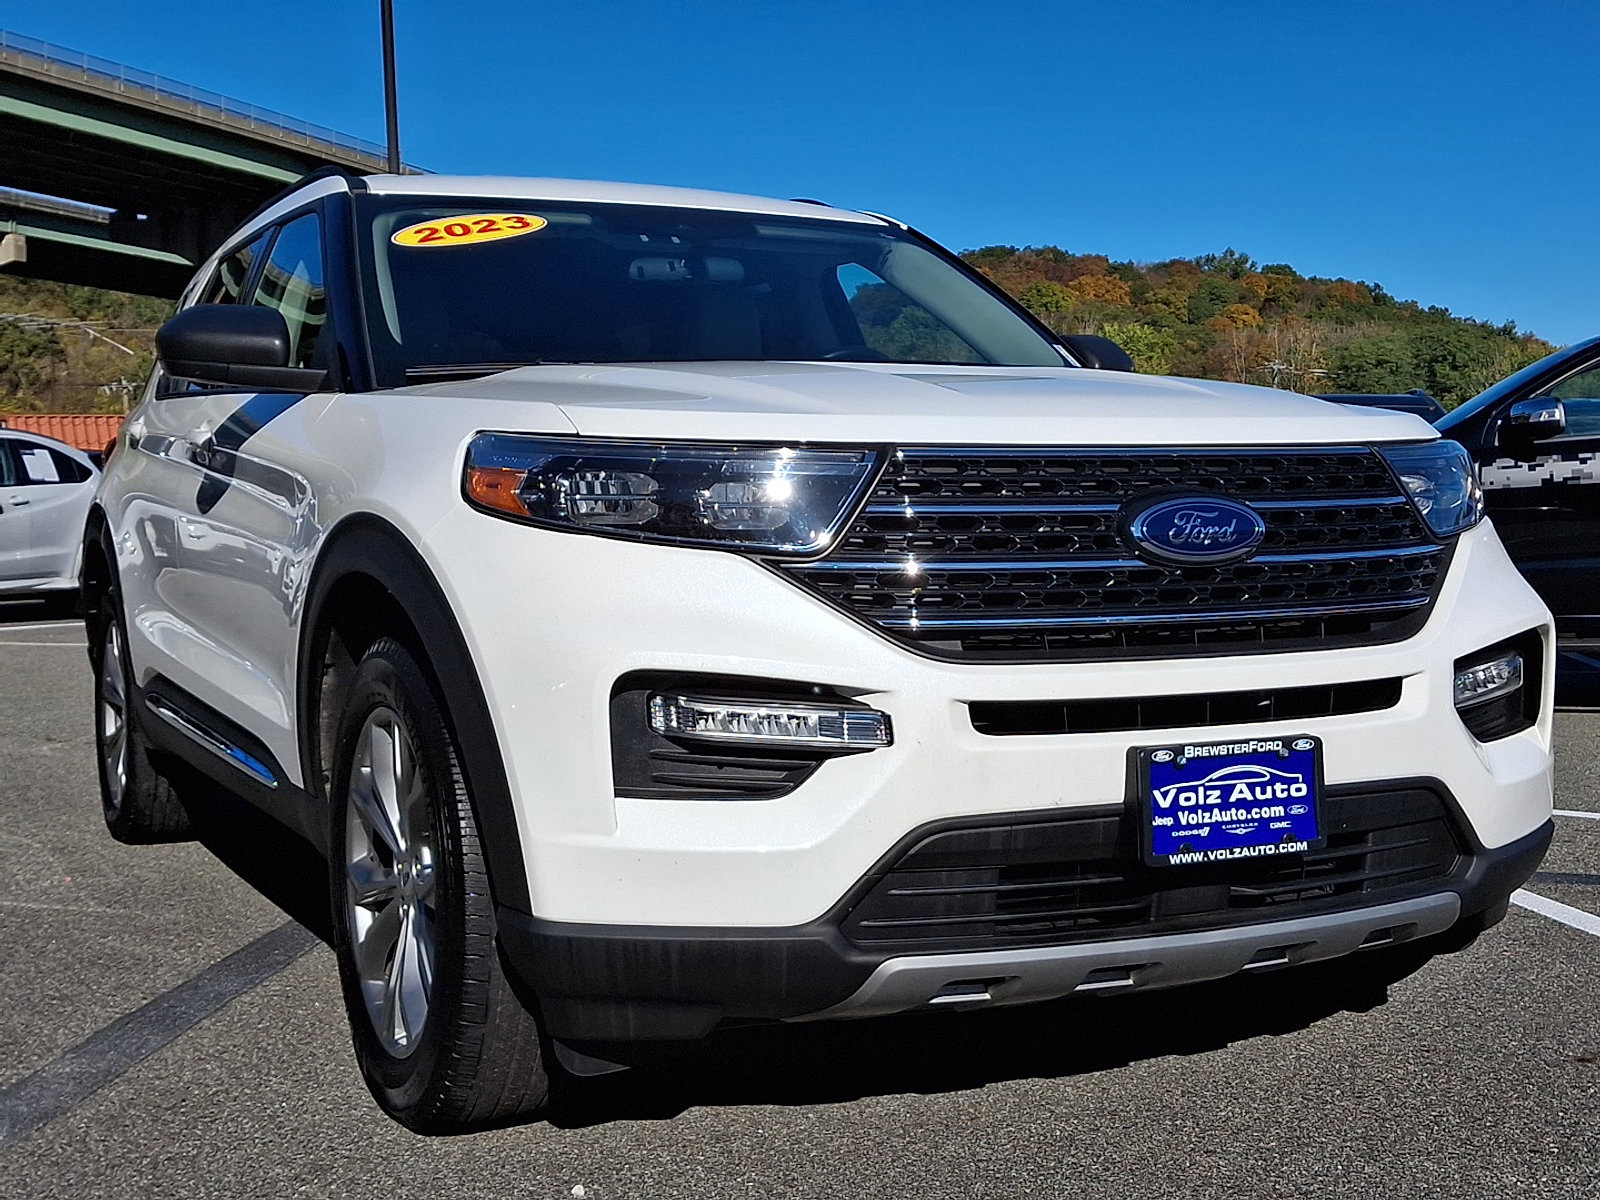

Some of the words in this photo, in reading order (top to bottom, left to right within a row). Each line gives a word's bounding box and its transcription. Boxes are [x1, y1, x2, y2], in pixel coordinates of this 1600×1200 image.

[414, 216, 531, 243] 2023
[1169, 510, 1237, 544] Ford
[1152, 786, 1222, 808] Volz
[1229, 782, 1308, 803] Auto
[1152, 816, 1174, 827] Jeep
[1178, 805, 1285, 826] VolzAuto.com
[1270, 821, 1292, 829] GMC
